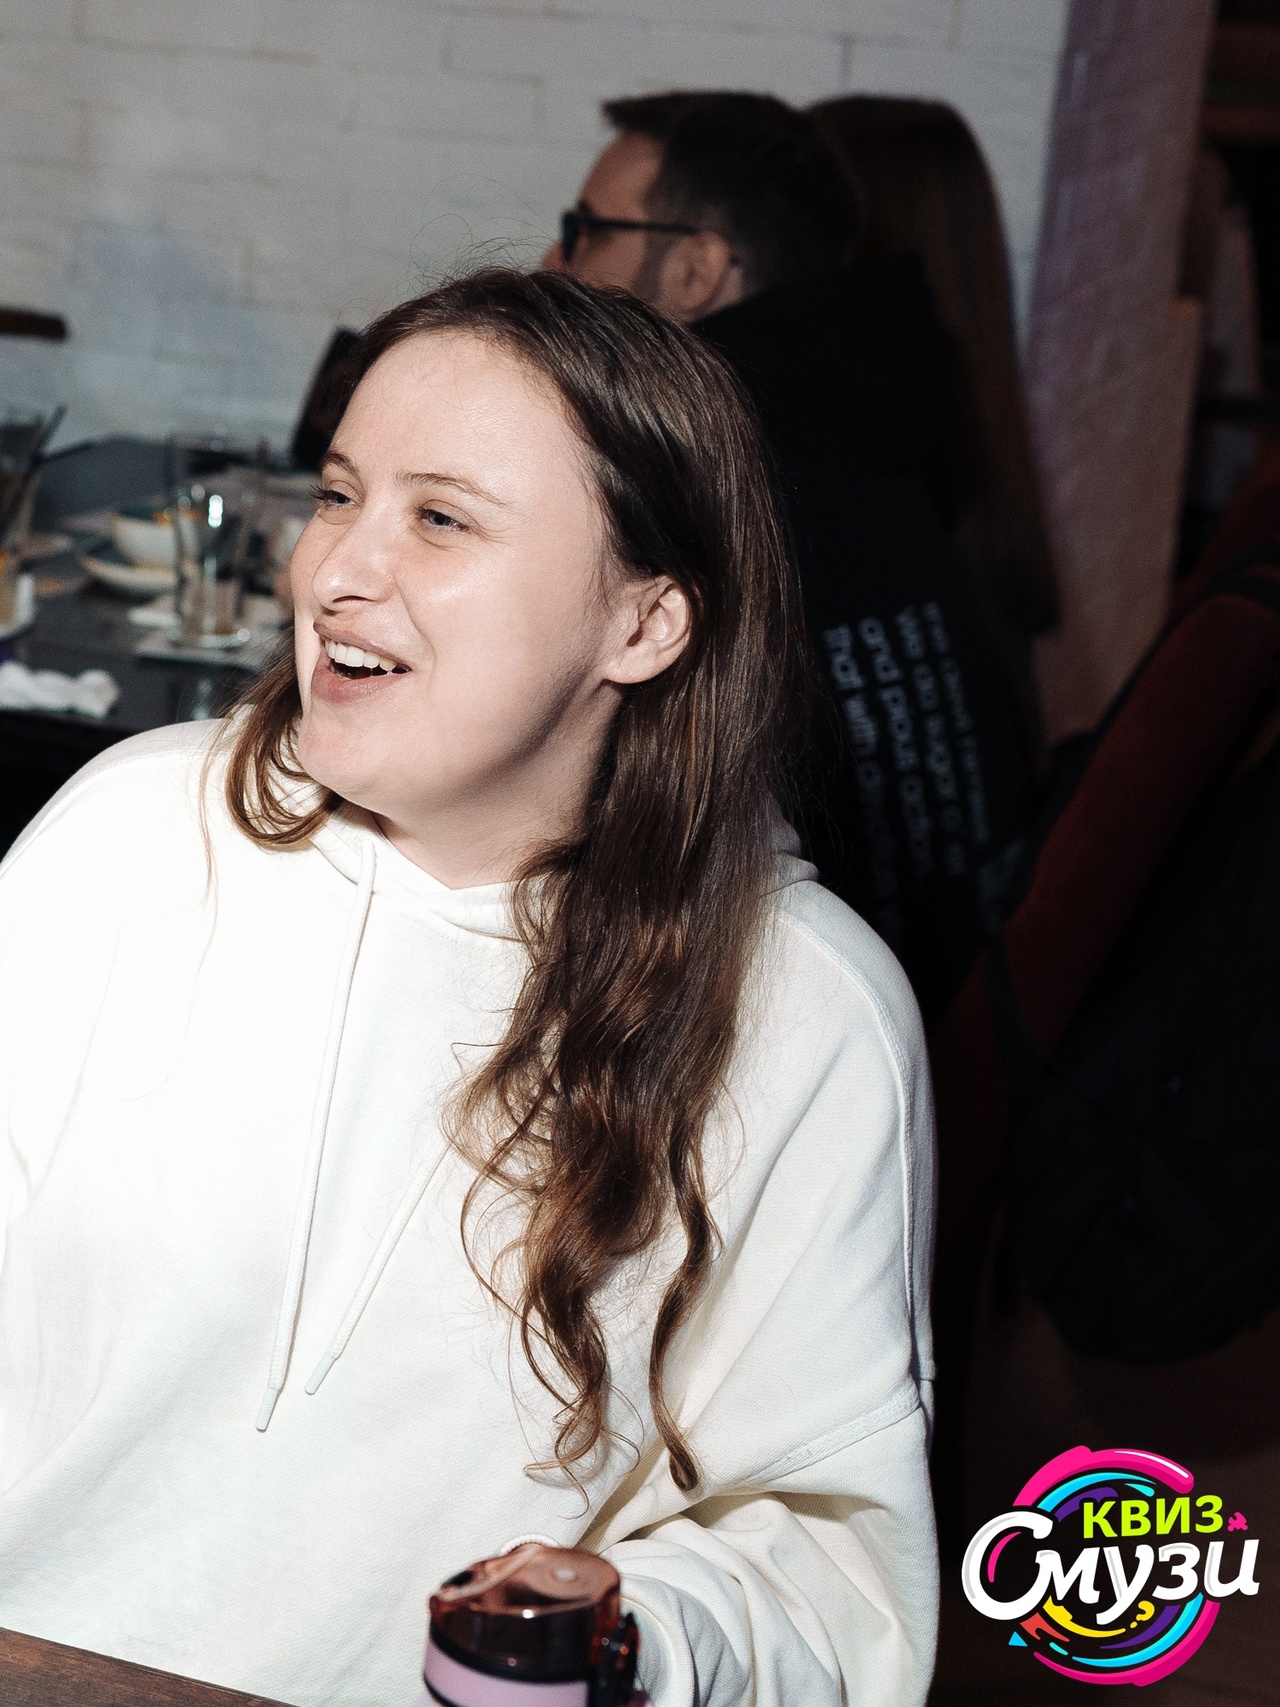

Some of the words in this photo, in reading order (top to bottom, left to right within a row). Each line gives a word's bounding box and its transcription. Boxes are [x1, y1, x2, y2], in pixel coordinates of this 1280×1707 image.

[821, 622, 868, 692] that
[858, 615, 905, 685] and
[842, 690, 881, 760] with
[876, 684, 921, 774] pious
